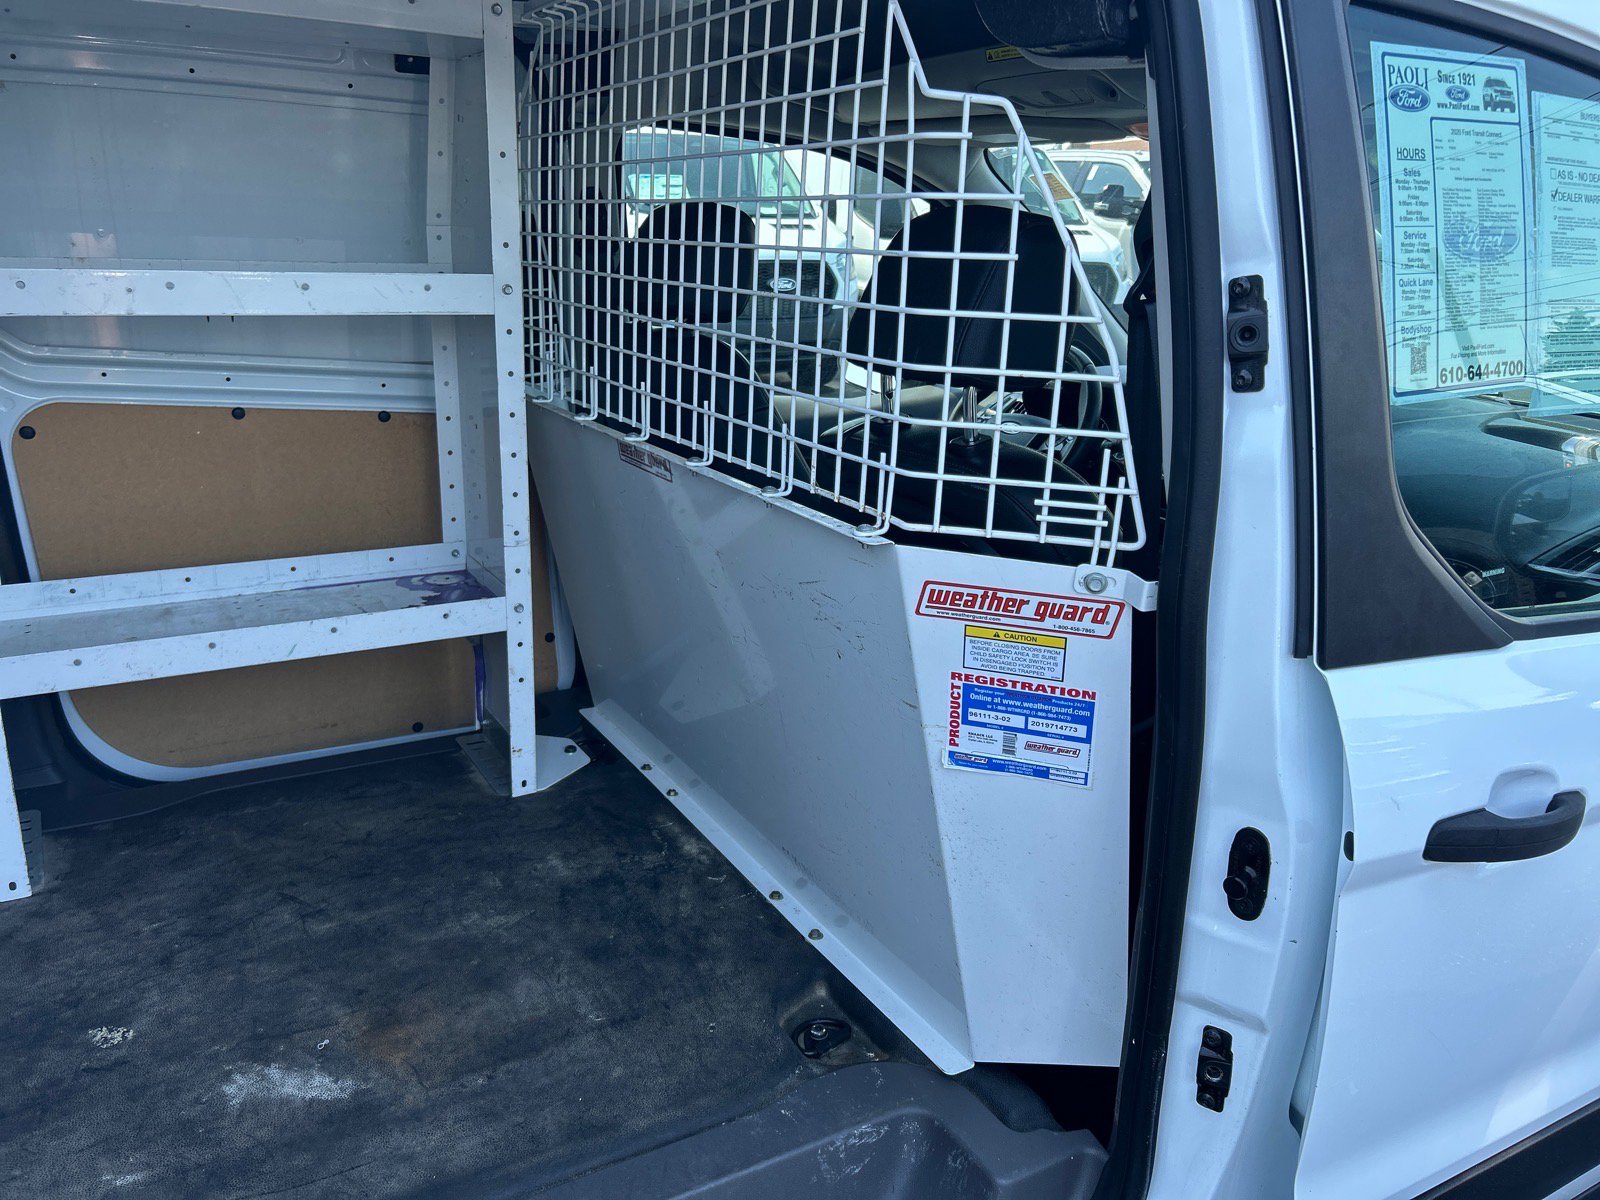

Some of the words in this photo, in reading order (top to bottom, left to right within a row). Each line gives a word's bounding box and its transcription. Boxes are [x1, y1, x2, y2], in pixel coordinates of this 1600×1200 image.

[1387, 64, 1429, 91] PAOLI
[1458, 72, 1476, 86] 1921
[1397, 90, 1422, 108] Ford
[1450, 88, 1466, 100] Ford
[1437, 102, 1480, 112] www.PaoliFord.com
[1396, 147, 1426, 160] HOURS
[1404, 168, 1421, 177] Sales
[1558, 170, 1566, 180] AS
[1568, 170, 1574, 180] IS
[1578, 172, 1588, 182] NO
[1558, 192, 1582, 203] DEALER
[1404, 230, 1426, 240] Service
[1399, 278, 1417, 287] Quick
[1418, 278, 1433, 286] Lane
[1401, 326, 1432, 336] Bodyshop
[1440, 360, 1523, 384] 610-644-4700
[926, 588, 1030, 614] weather
[1034, 600, 1110, 625] guard
[936, 610, 1002, 622] www.weatherguard.com
[1004, 632, 1038, 643] CAUTION
[994, 642, 1020, 650] CLOSING
[1020, 646, 1042, 654] DOORS
[980, 658, 1018, 667] DISENGAGED
[1018, 662, 1046, 672] POSITION
[1028, 658, 1052, 666] SWITCH
[950, 672, 1096, 700] REGISTRATION
[970, 692, 992, 702] Online
[1002, 698, 1090, 716] www.weatherguard.com
[1052, 699, 1073, 707] Products
[949, 682, 962, 747] PRODUCT
[968, 711, 1011, 722] 96111-3-02
[1030, 720, 1078, 732] 2019714773
[1026, 742, 1056, 752] weather
[1056, 747, 1077, 756] guard
